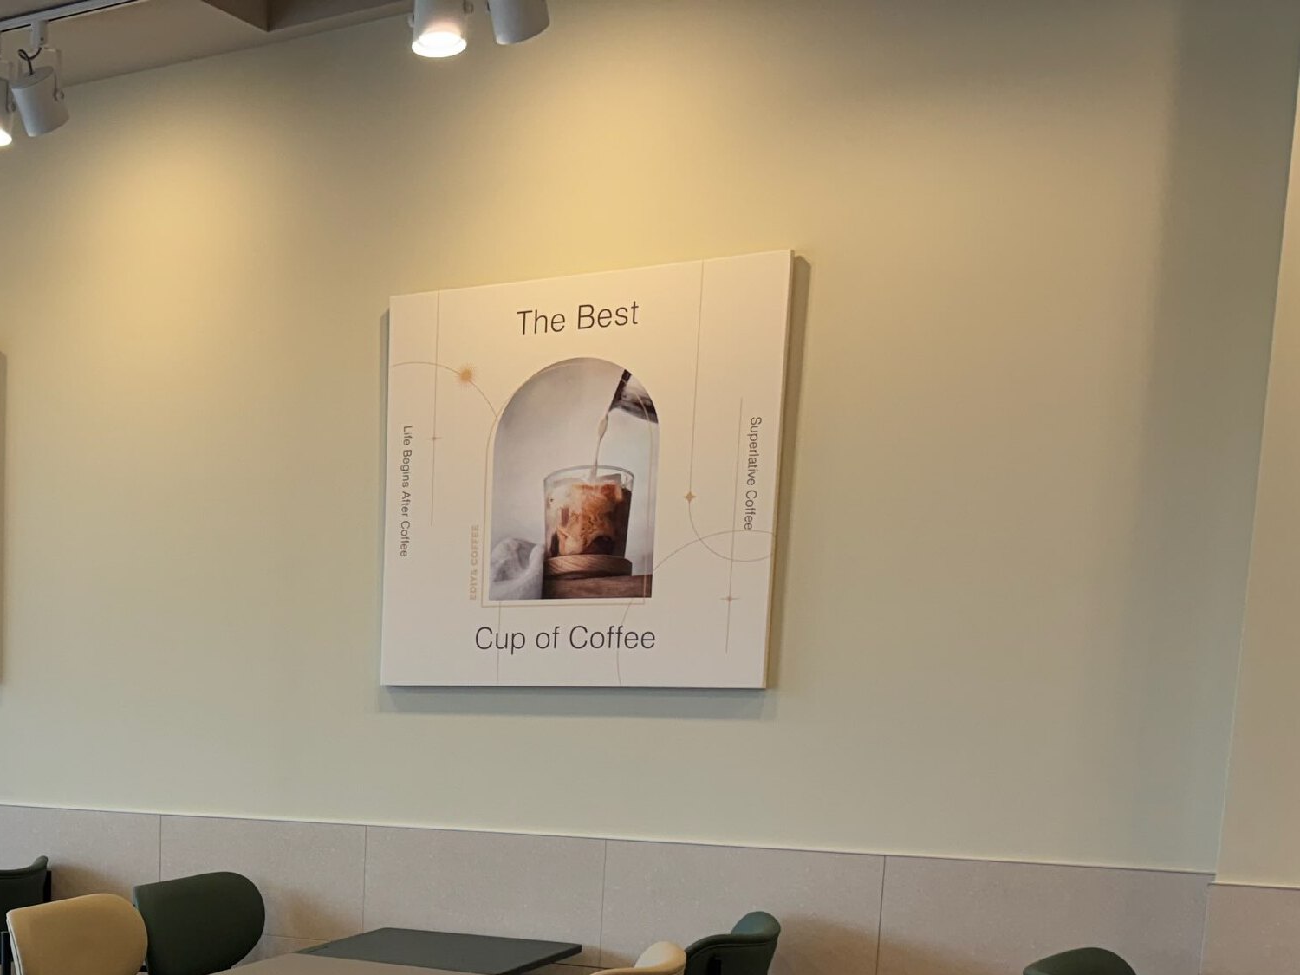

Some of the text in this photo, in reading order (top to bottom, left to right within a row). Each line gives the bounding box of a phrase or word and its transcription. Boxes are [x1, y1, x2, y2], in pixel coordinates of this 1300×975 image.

[517, 300, 640, 335] The Best
[402, 425, 413, 446] Life
[743, 416, 763, 532] Superlative Coffee
[400, 490, 411, 518] After
[399, 520, 411, 558] Coffee
[475, 624, 656, 656] Cup of Coffee
